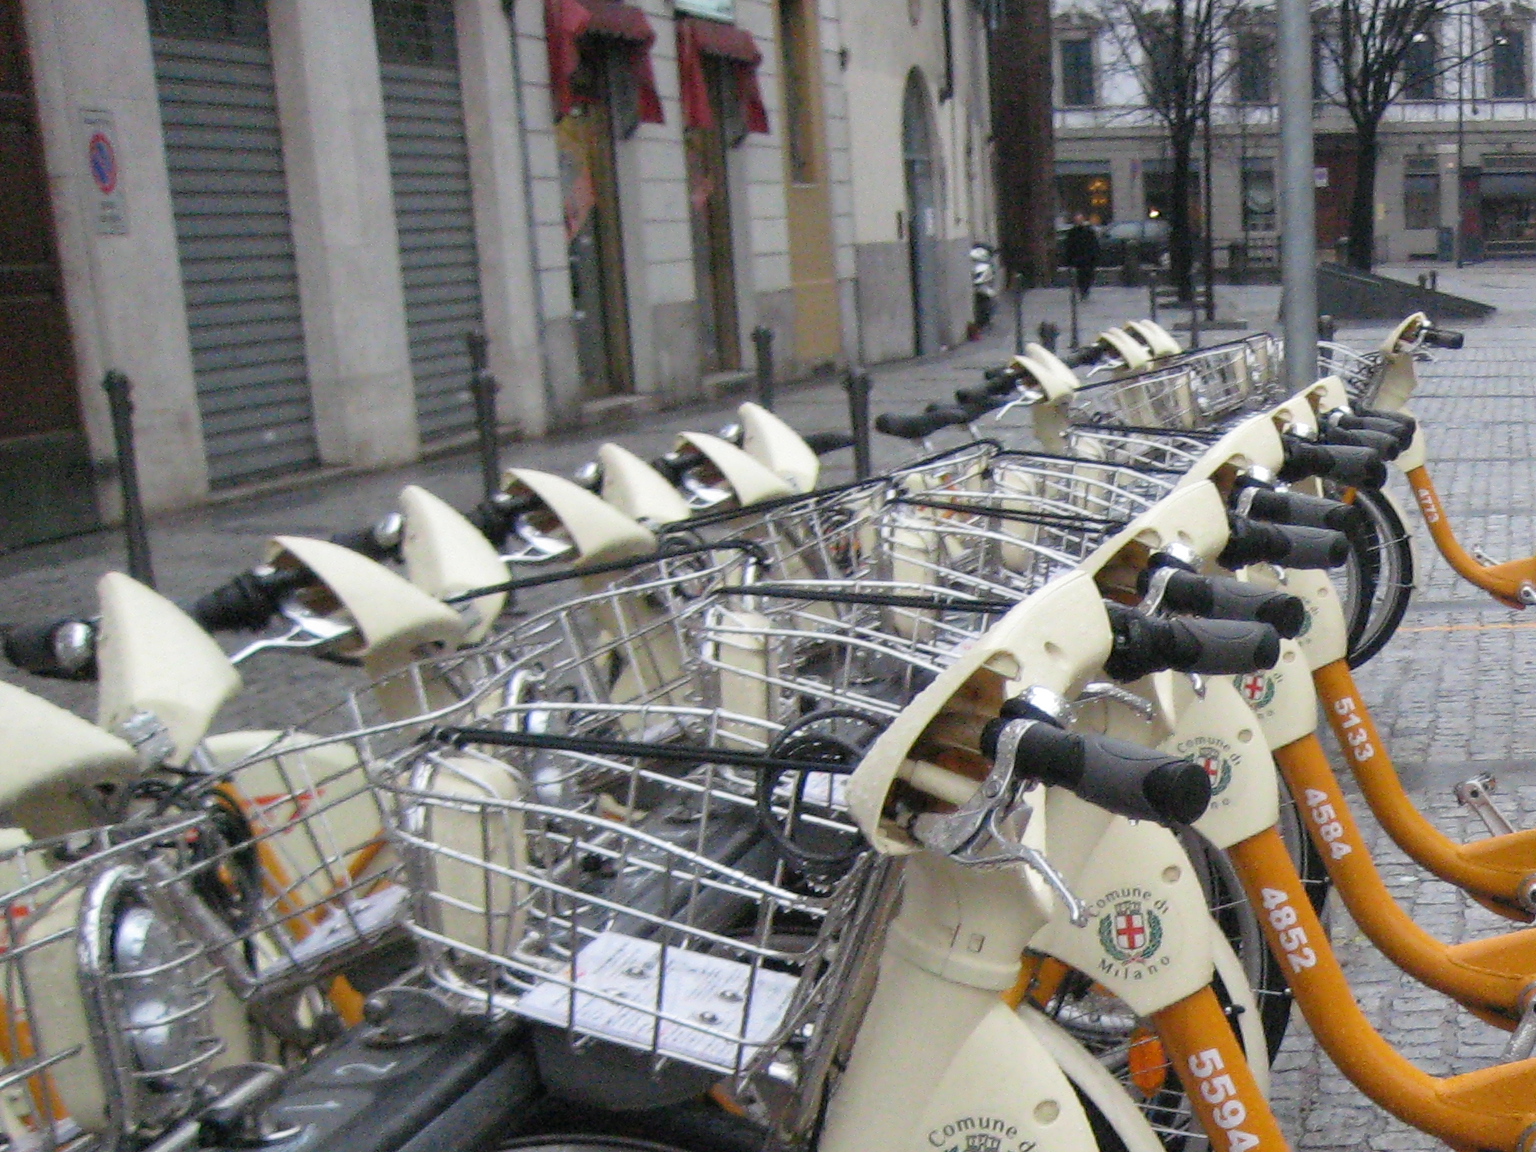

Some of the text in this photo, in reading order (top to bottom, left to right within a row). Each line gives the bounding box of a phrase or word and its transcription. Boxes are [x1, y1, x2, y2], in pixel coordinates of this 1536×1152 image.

[1177, 737, 1231, 753] Comune
[1334, 697, 1375, 761] 5133
[1305, 788, 1353, 860] 4584
[1087, 887, 1170, 918] Comune di
[1261, 888, 1318, 973] 4852
[1098, 956, 1170, 980] Milano
[928, 1116, 1019, 1148] Comune
